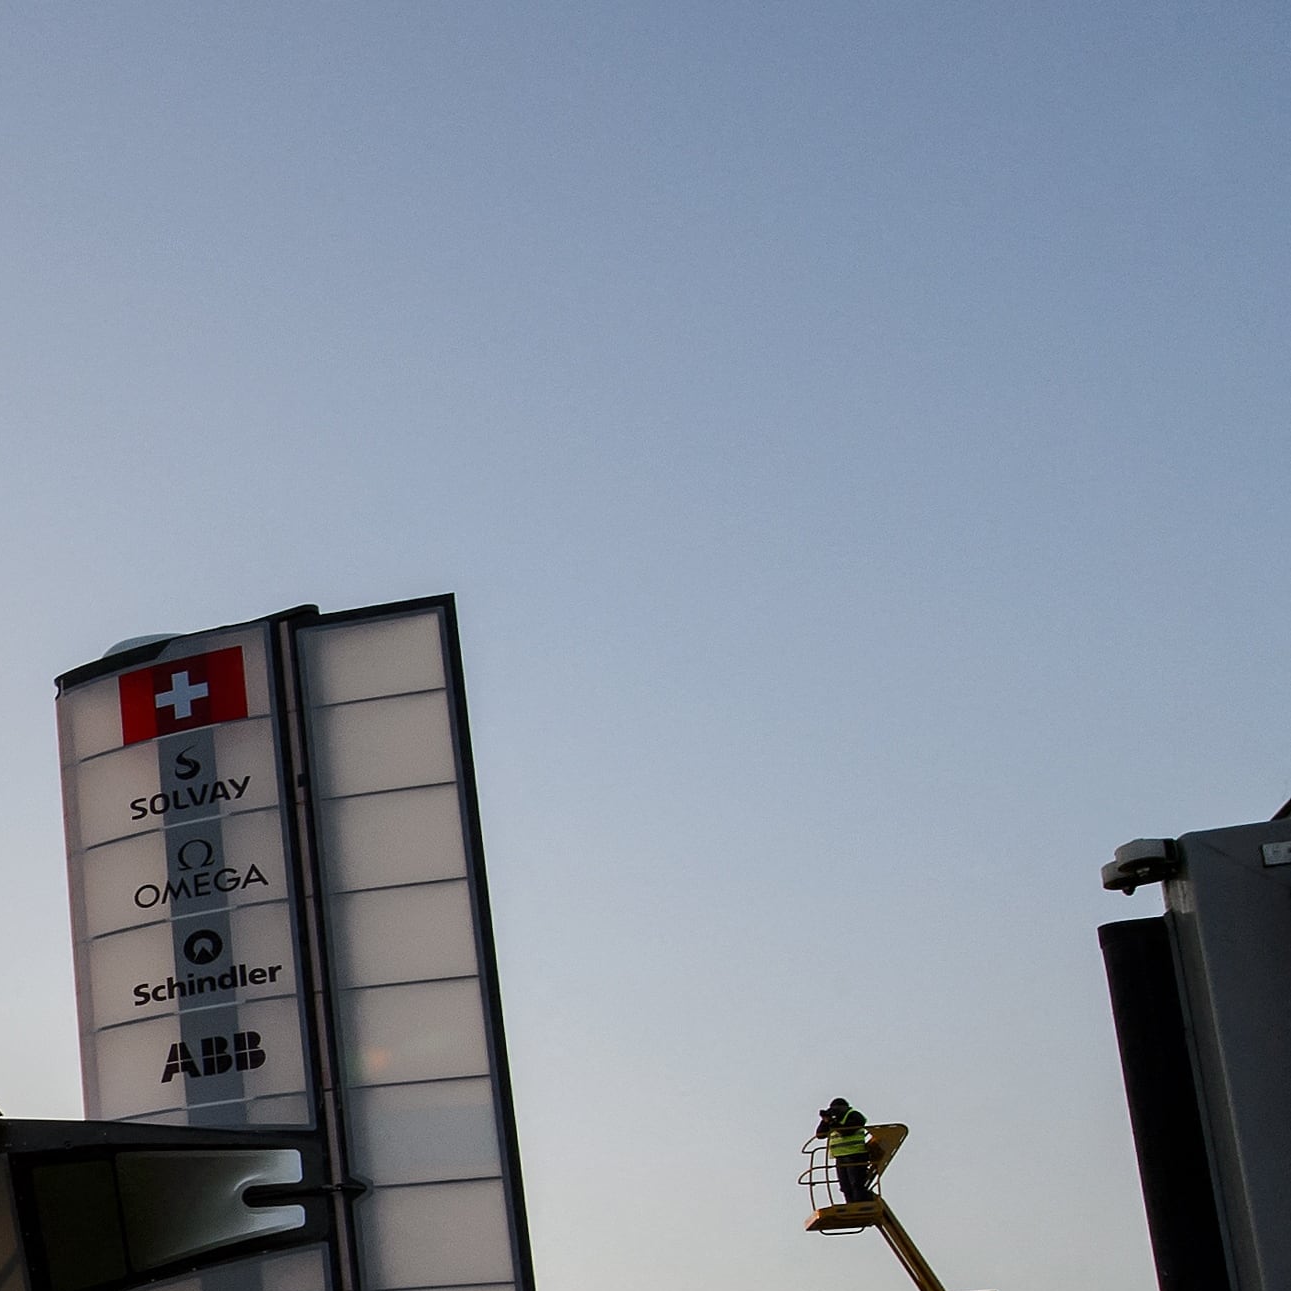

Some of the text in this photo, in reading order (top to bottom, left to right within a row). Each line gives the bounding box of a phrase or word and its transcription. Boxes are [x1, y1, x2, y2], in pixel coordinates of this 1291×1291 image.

[130, 776, 251, 820] SOLVAY
[134, 863, 269, 909] OMEGA
[133, 964, 282, 1006] Schindler
[161, 1031, 266, 1083] ABB
